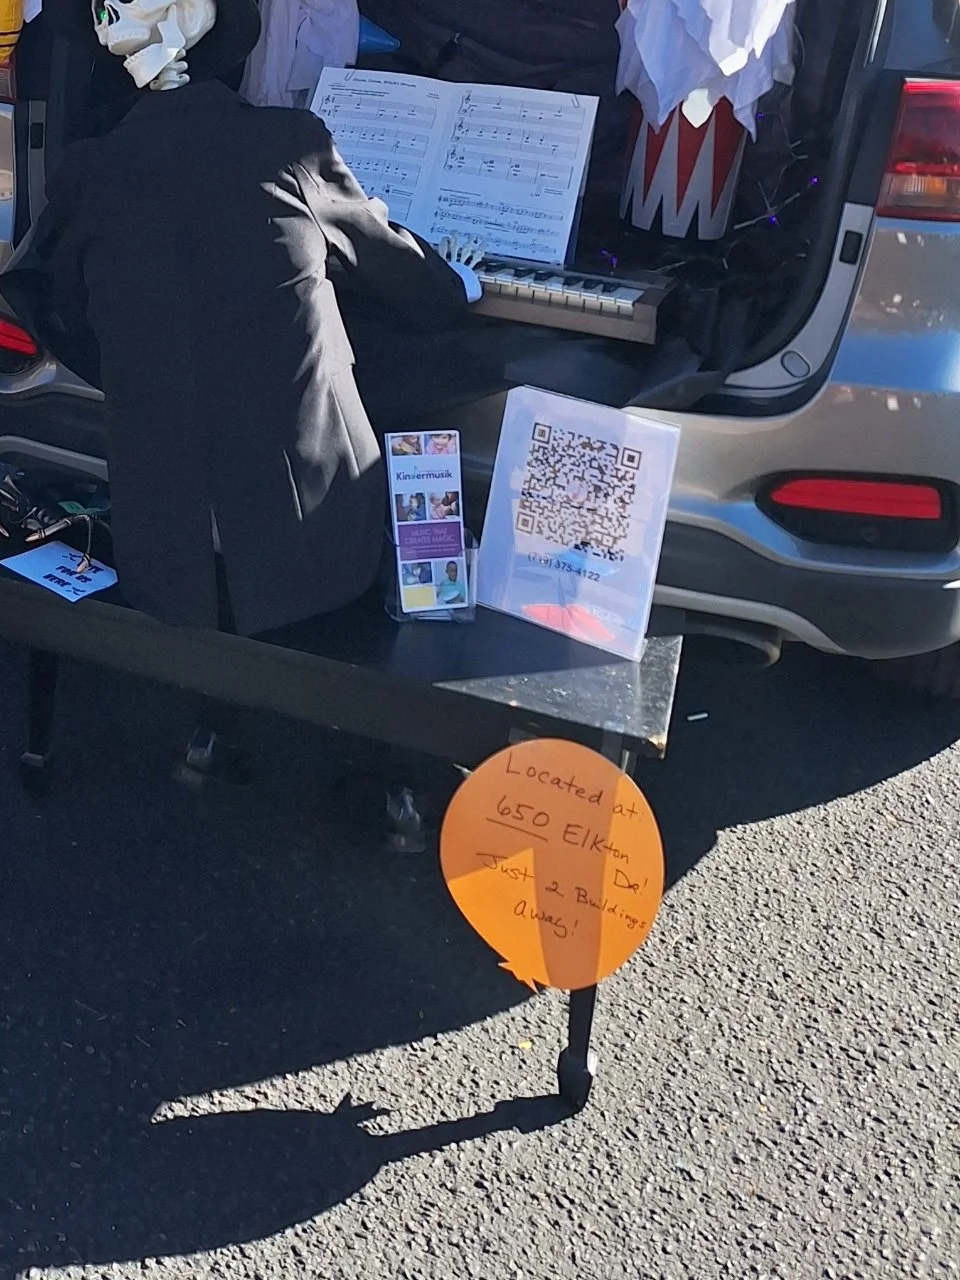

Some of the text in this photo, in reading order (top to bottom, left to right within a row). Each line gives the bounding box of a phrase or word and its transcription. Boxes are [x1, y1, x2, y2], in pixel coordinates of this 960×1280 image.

[396, 465, 452, 480] Kindermusik
[554, 559, 600, 582] 375-4122
[506, 752, 603, 806] Located
[496, 795, 550, 827] 650
[476, 852, 647, 929] Just 2 Buildings
